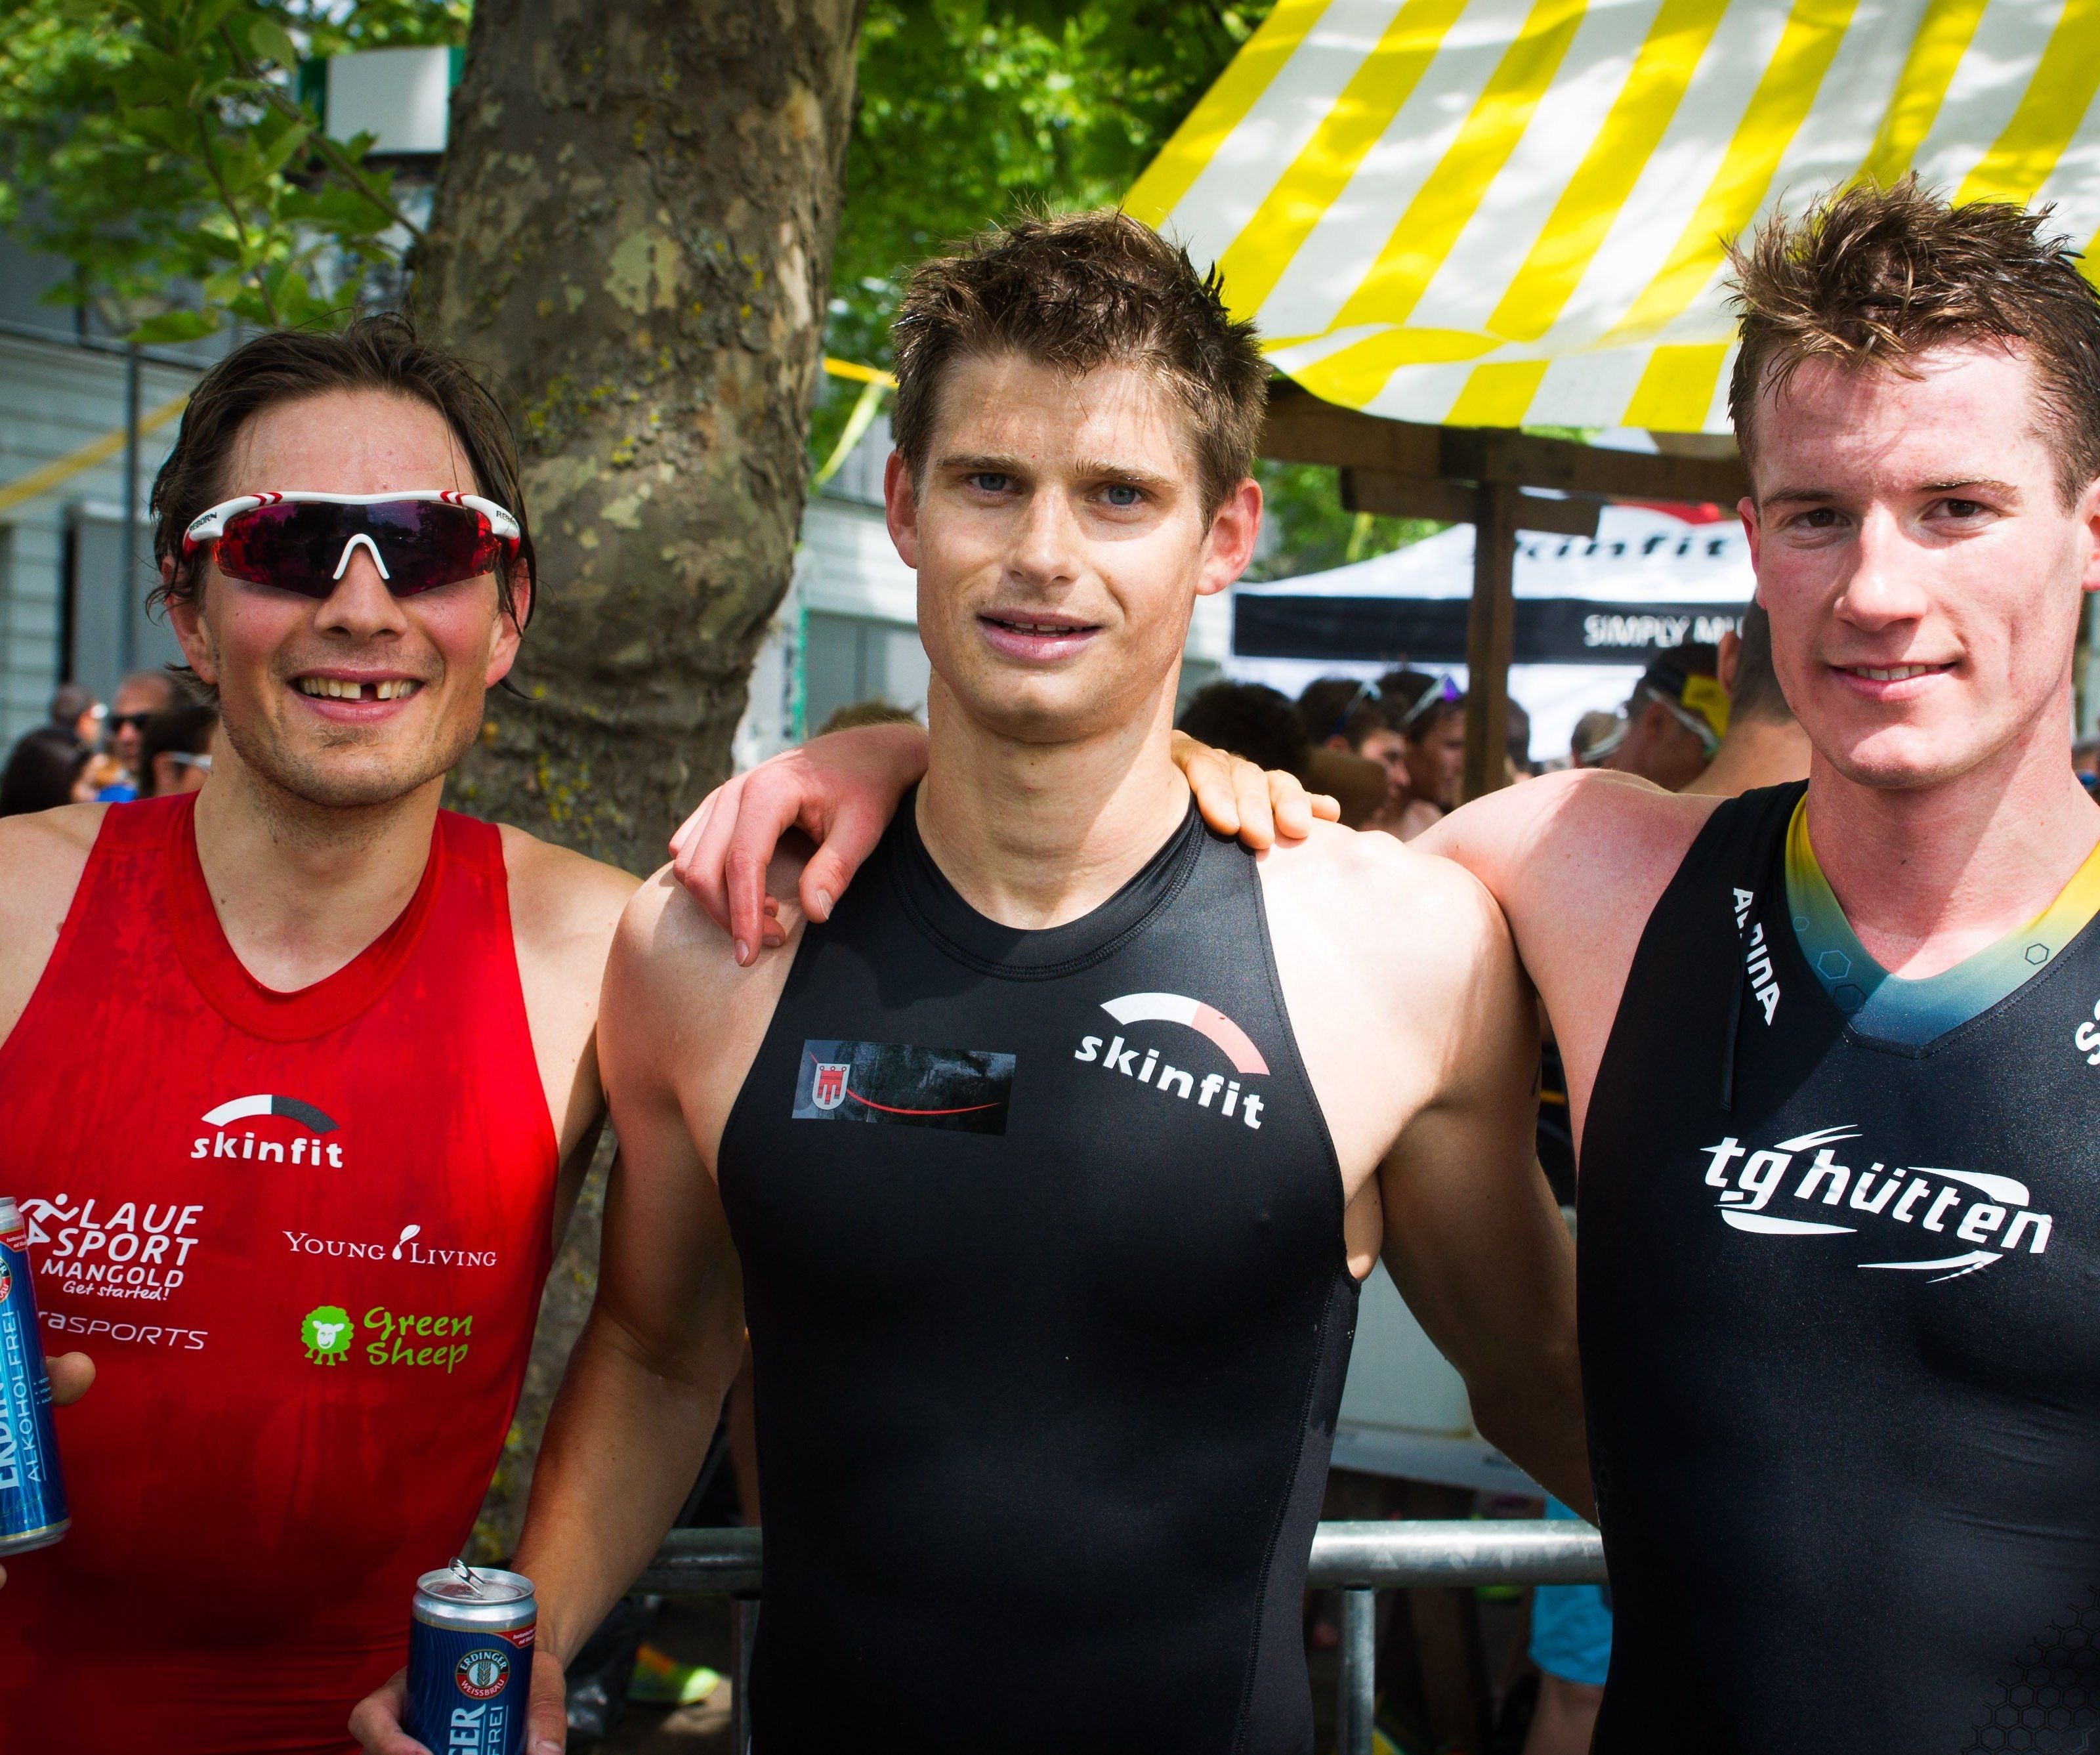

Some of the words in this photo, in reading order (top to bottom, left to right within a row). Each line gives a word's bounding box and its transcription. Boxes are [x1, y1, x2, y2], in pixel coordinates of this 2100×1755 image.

[1584, 614, 1690, 648] SIMPLY
[1074, 1035, 1265, 1130] skinfit
[190, 1131, 343, 1169] skinfit
[1700, 1137, 1793, 1210] tg
[1794, 1149, 2052, 1254] hütten
[79, 1198, 204, 1235] LAUF
[52, 1228, 199, 1266] SPORT
[283, 1231, 386, 1260] YOUNG
[410, 1242, 497, 1267] LIVING
[41, 1258, 184, 1288] MANGOLD
[63, 1280, 94, 1296] Get
[98, 1285, 170, 1301] started!
[364, 1306, 472, 1340] Green
[366, 1338, 469, 1373] Sheep
[2, 1311, 41, 1482] ALKOHOLFREI
[459, 1651, 507, 1670] ERDINGER
